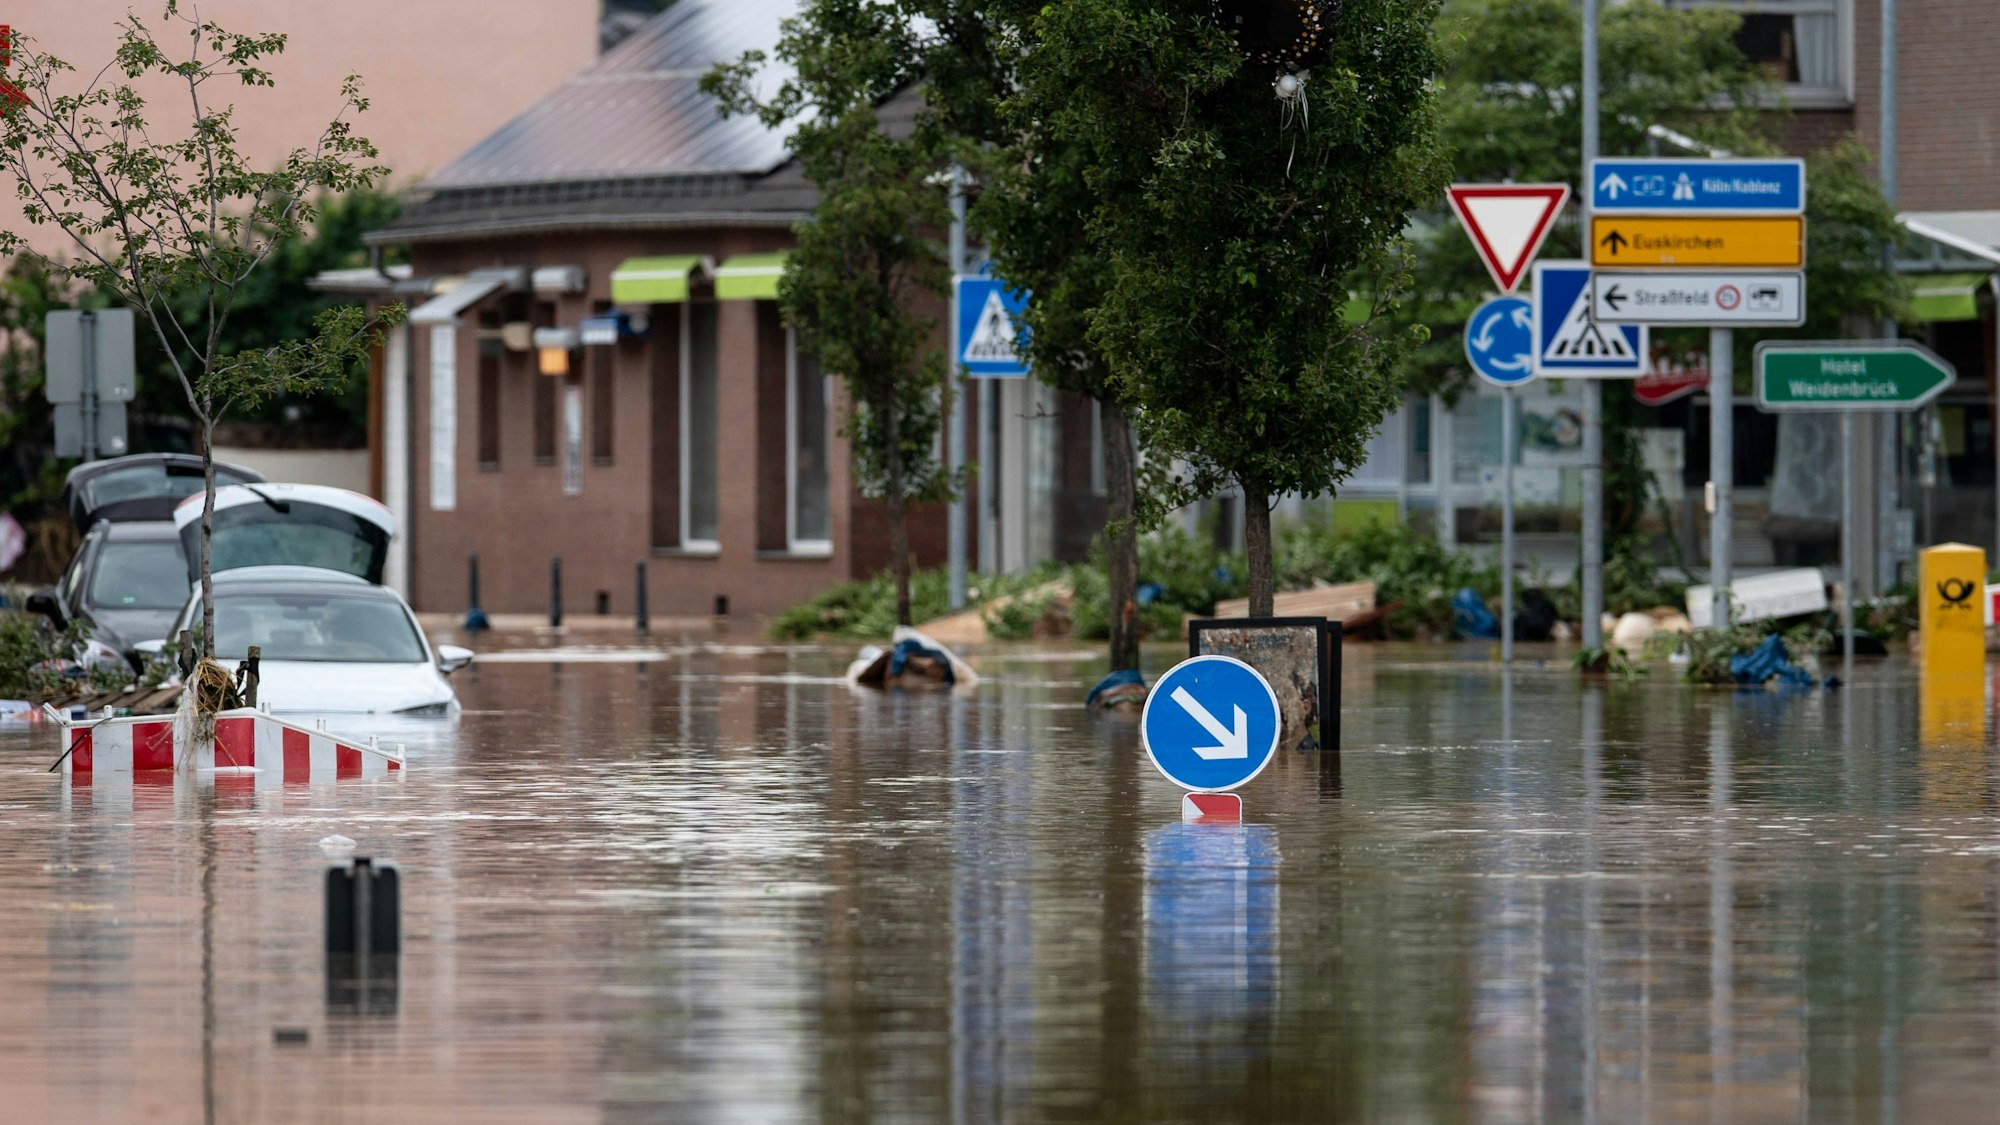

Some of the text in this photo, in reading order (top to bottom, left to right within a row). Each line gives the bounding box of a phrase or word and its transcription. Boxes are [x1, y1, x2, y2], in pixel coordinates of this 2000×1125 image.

[1633, 234, 1724, 249] Euskirchen
[1634, 290, 1709, 306] Straßfeld
[1820, 358, 1866, 375] Hotel
[1789, 379, 1898, 397] Weidenbrück
